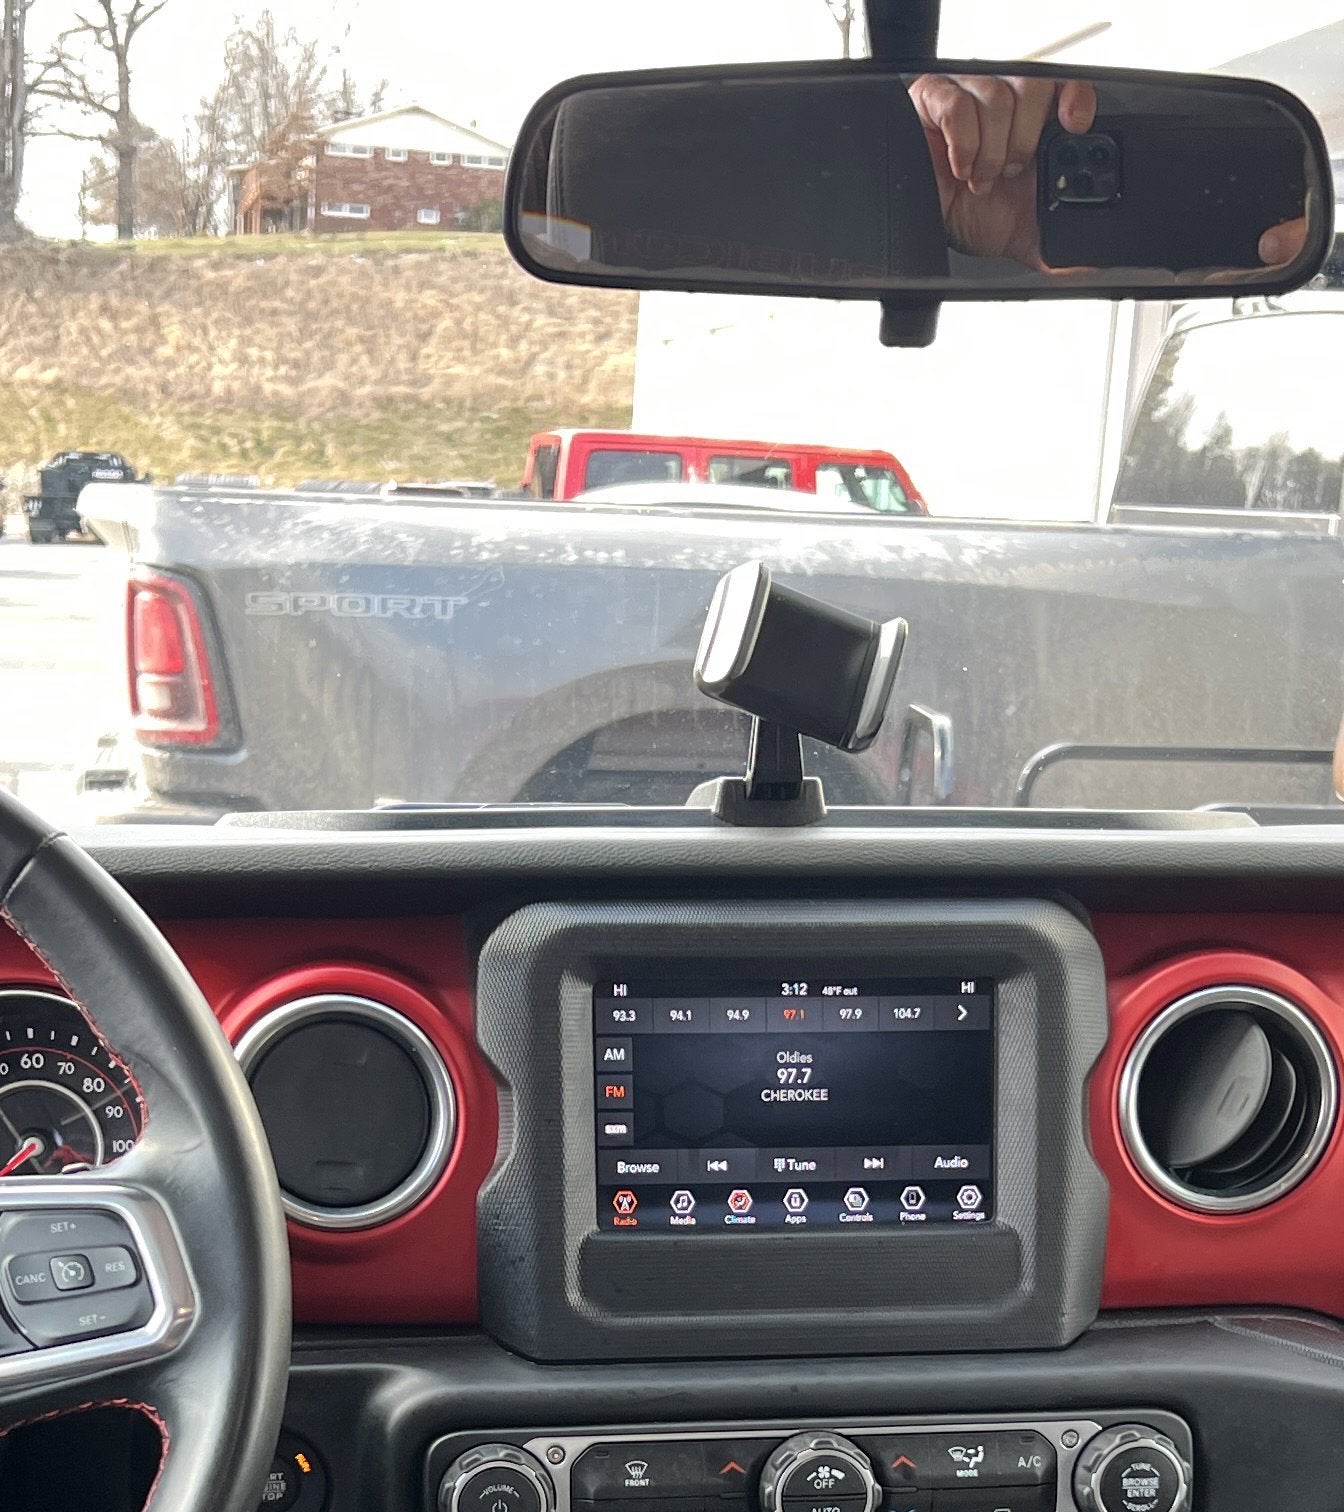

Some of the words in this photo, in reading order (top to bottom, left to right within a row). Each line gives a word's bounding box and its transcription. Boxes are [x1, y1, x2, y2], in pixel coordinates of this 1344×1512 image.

[245, 592, 469, 619] SPORT
[613, 984, 627, 997] HI
[781, 983, 808, 996] 3:12
[961, 982, 974, 994] HI
[612, 1010, 636, 1022] 93.3
[670, 1010, 692, 1021] 94.1
[726, 1010, 750, 1021] 94.9
[839, 1008, 862, 1020] 97.9
[894, 1008, 921, 1020] 104.7
[604, 1048, 624, 1061] AM
[776, 1051, 813, 1064] Oldies
[20, 1054, 44, 1070] 60
[56, 1062, 74, 1075] 70
[777, 1068, 812, 1084] 97.7
[82, 1077, 106, 1093] 80
[606, 1086, 624, 1098] FM
[760, 1088, 829, 1102] CHEROKEE
[105, 1106, 124, 1120] 90
[616, 1161, 660, 1174] Browse
[786, 1158, 817, 1171] Tune
[934, 1156, 969, 1169] Audio
[670, 1216, 696, 1226] Media
[724, 1215, 756, 1224] Climate
[784, 1214, 807, 1224] Apps
[838, 1212, 874, 1222] Controls
[899, 1212, 926, 1221] Phone
[952, 1210, 986, 1221] Settings
[105, 1262, 126, 1272] RES
[15, 1272, 46, 1286] CANC
[1017, 1456, 1042, 1468] A/C
[956, 1469, 978, 1478] MODE
[624, 1478, 650, 1487] FRONT
[813, 1478, 836, 1490] OFF
[1122, 1476, 1160, 1487] BROWSE
[482, 1484, 515, 1495] VOLUME
[1126, 1488, 1156, 1498] ENTER
[262, 1492, 284, 1500] TOP
